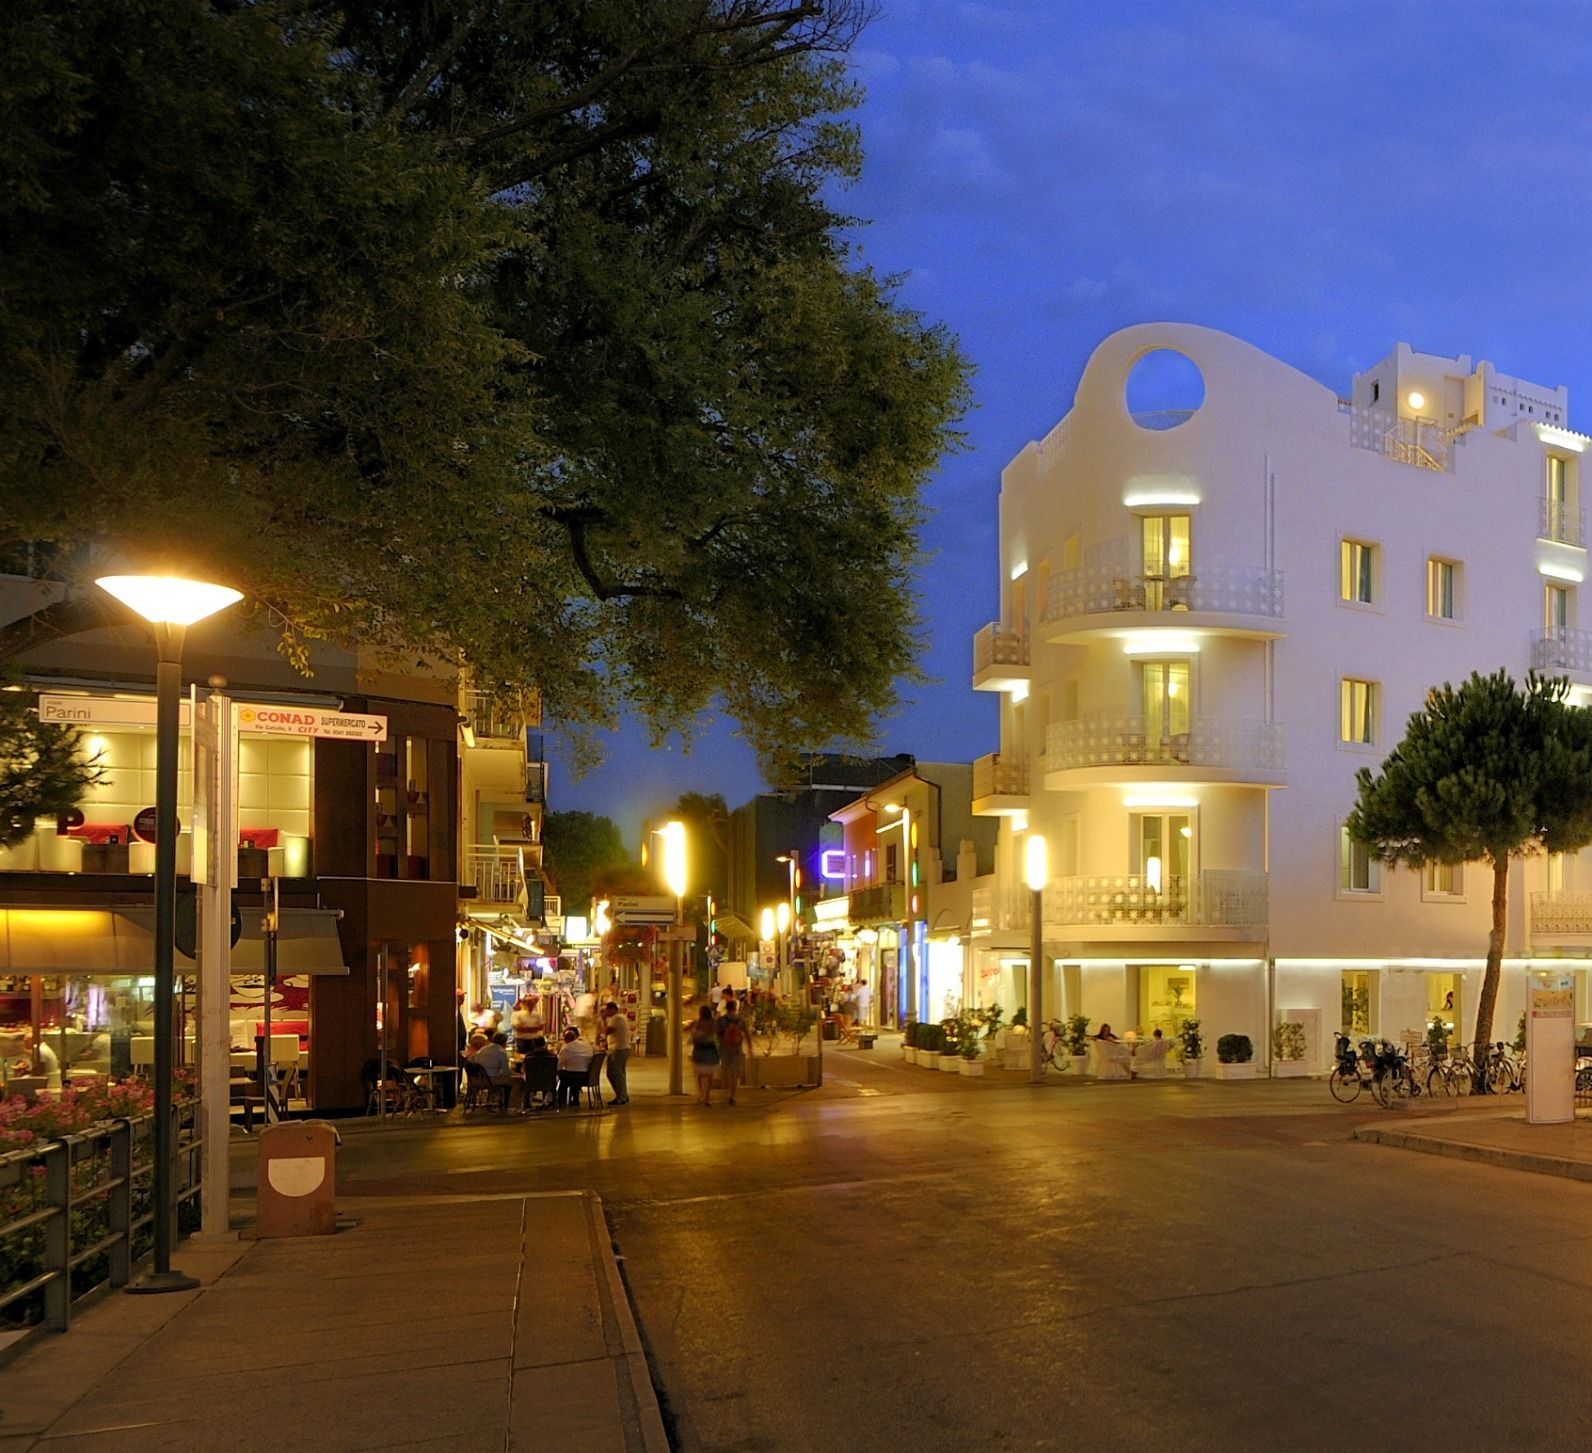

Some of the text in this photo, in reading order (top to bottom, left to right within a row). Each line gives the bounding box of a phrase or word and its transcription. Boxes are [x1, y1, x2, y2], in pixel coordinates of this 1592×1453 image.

[46, 706, 92, 719] Parini
[257, 712, 315, 725] CONAD
[321, 717, 366, 728] SUPERMERCATO
